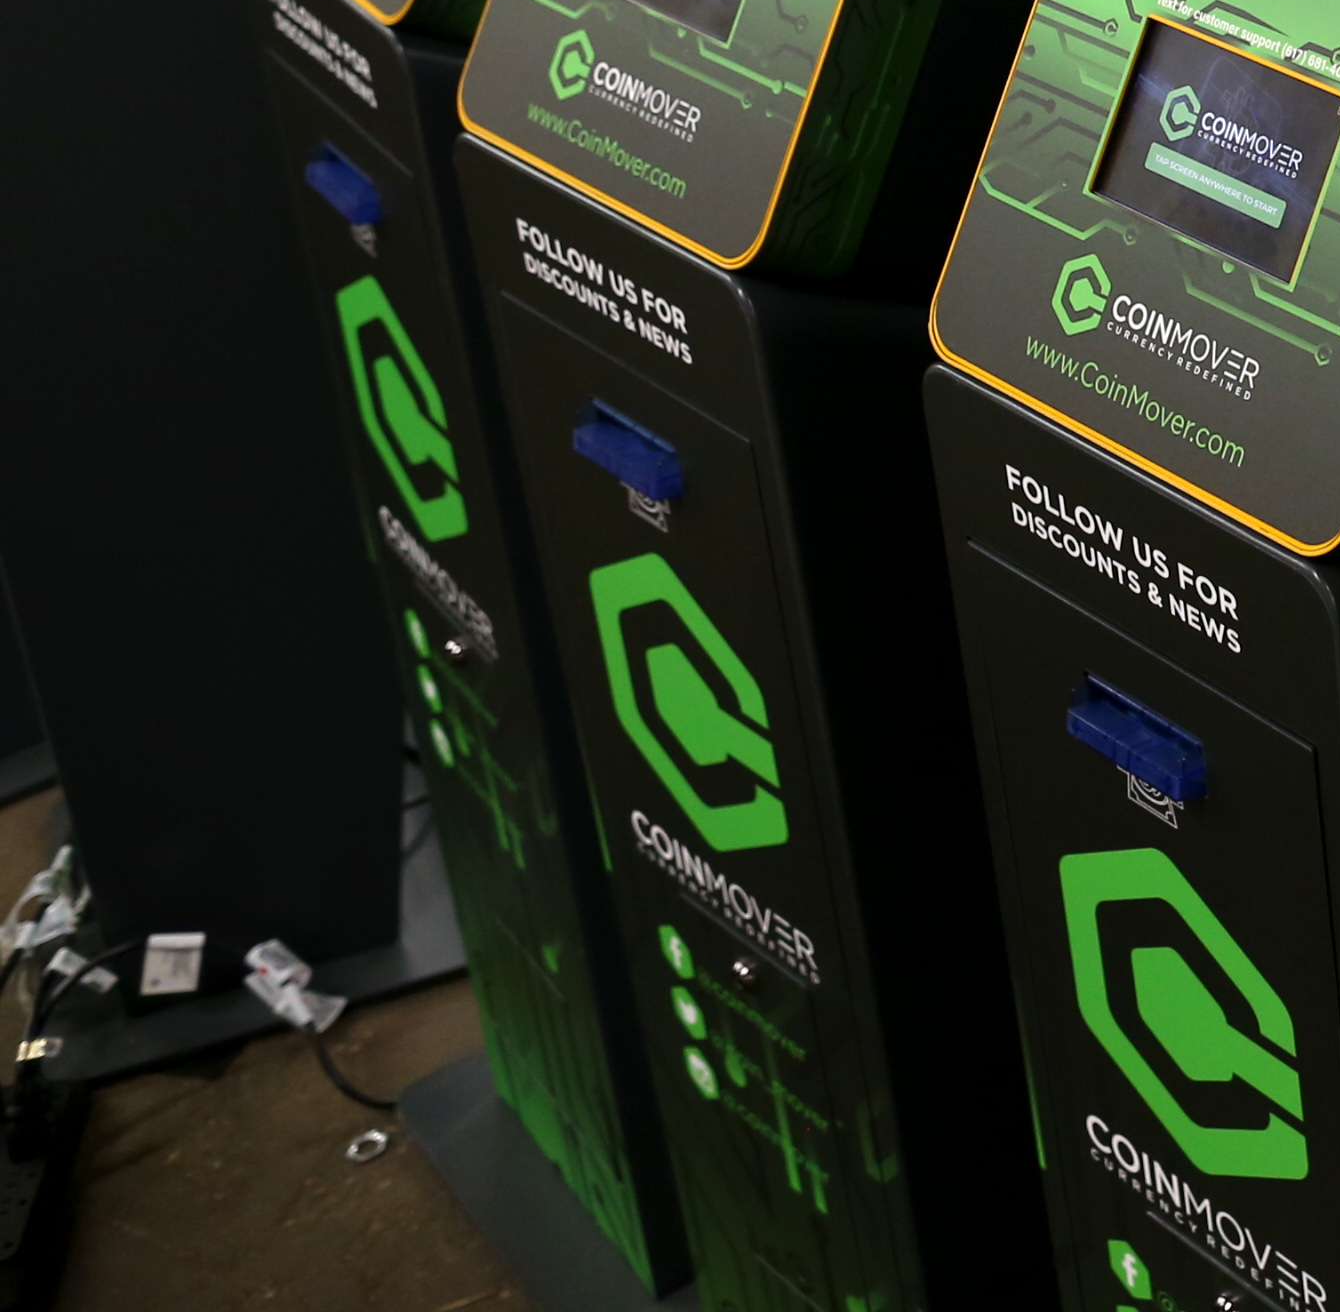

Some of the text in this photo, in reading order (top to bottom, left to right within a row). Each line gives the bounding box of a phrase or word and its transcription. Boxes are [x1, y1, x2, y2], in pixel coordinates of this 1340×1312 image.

[1177, 1, 1193, 18] for
[1193, 10, 1241, 36] customer
[1240, 28, 1282, 53] support
[1281, 41, 1308, 65] (617)
[593, 62, 700, 133] COINMOVER
[1199, 111, 1303, 171] COINMOVER
[528, 101, 685, 199] www.CoinMover.com
[1154, 153, 1278, 215] TAP SCREEN ANYWHERE TO START
[1197, 129, 1297, 179] CURRENCY REDEFINED
[516, 218, 688, 335] FOLLOW US FOR
[523, 252, 692, 364] DISCOUNTS & NEWS
[1106, 320, 1251, 401] CURRENCY REDEFINED
[1111, 294, 1260, 389] COINMOVER
[1026, 334, 1244, 468] www.CoinMover.com
[1005, 465, 1239, 621] FOLLOW US FOR
[1011, 502, 1241, 653] DISCOUNTS & NEWS
[631, 809, 818, 970] COINMOVER
[1086, 1114, 1327, 1312] COINMOVER
